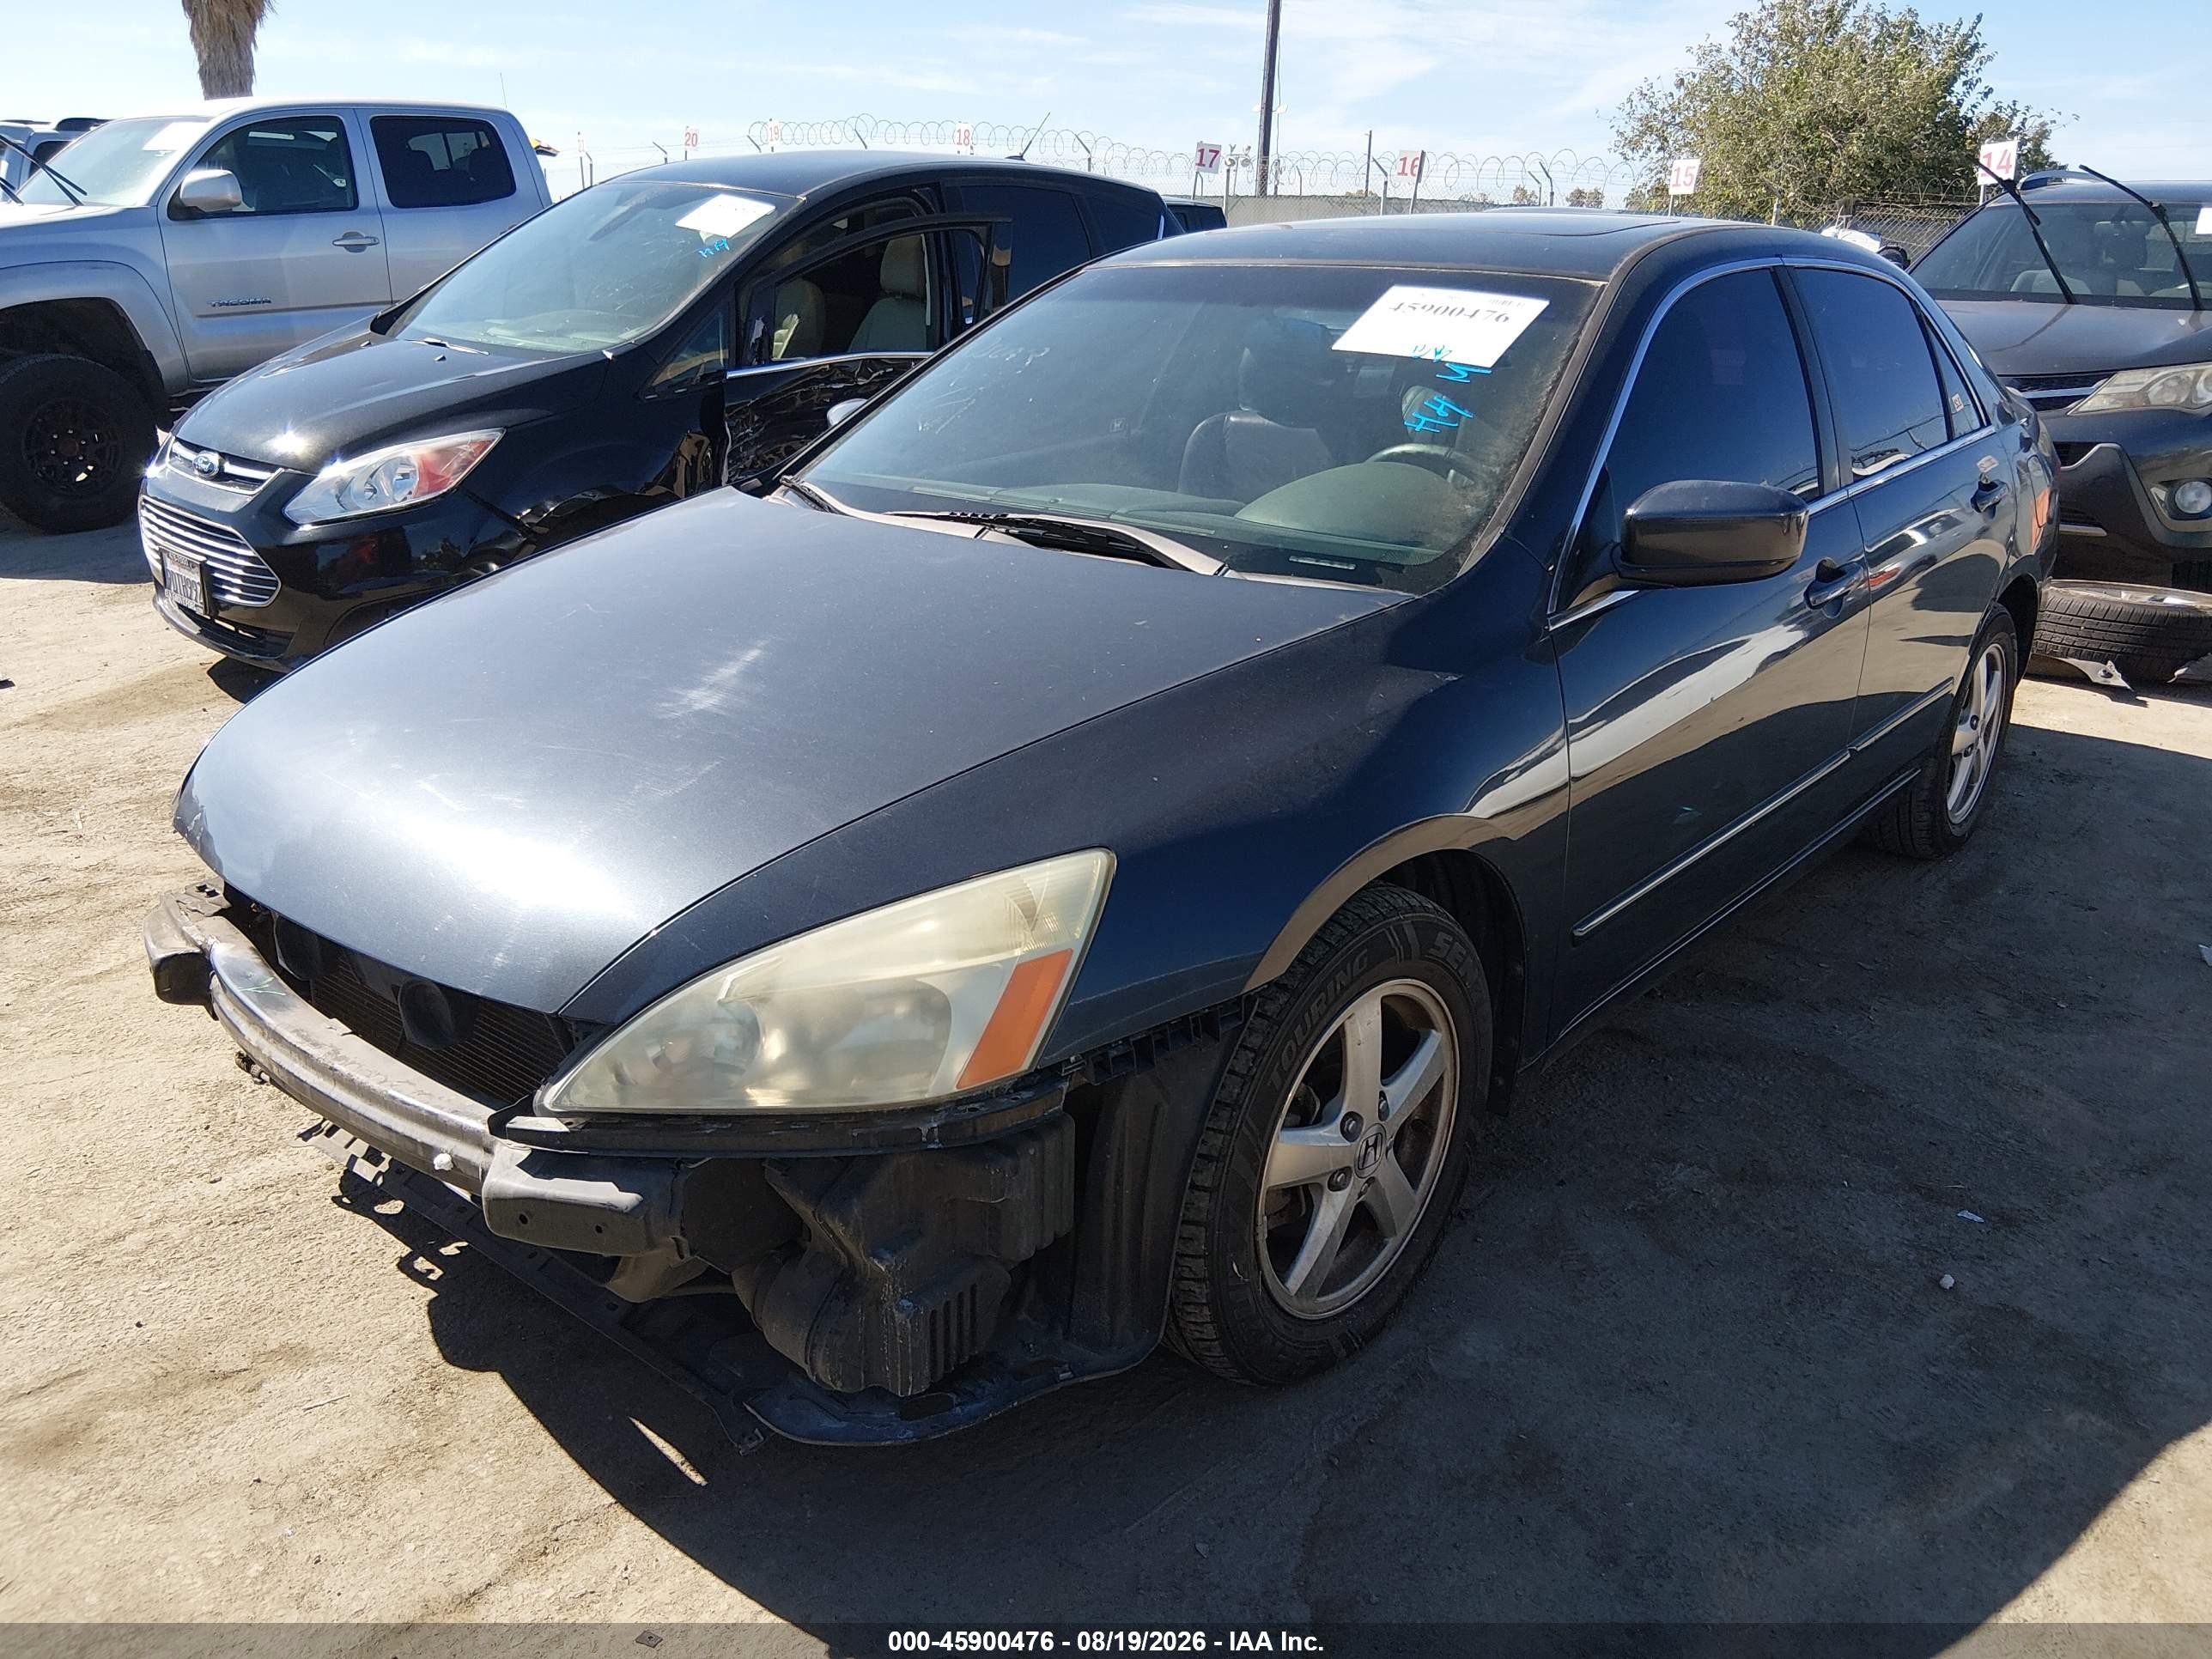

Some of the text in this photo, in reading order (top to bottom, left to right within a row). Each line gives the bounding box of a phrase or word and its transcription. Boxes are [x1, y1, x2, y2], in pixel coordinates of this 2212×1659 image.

[684, 132, 698, 147] 20
[769, 125, 780, 142] 19
[956, 129, 971, 146] 18
[1194, 148, 1220, 168] 17
[1980, 149, 2012, 177] 14
[1671, 166, 1696, 188] 15
[210, 297, 272, 307] TACOMA
[1389, 301, 1510, 323] 45900476
[1267, 948, 1369, 1091] TOURING
